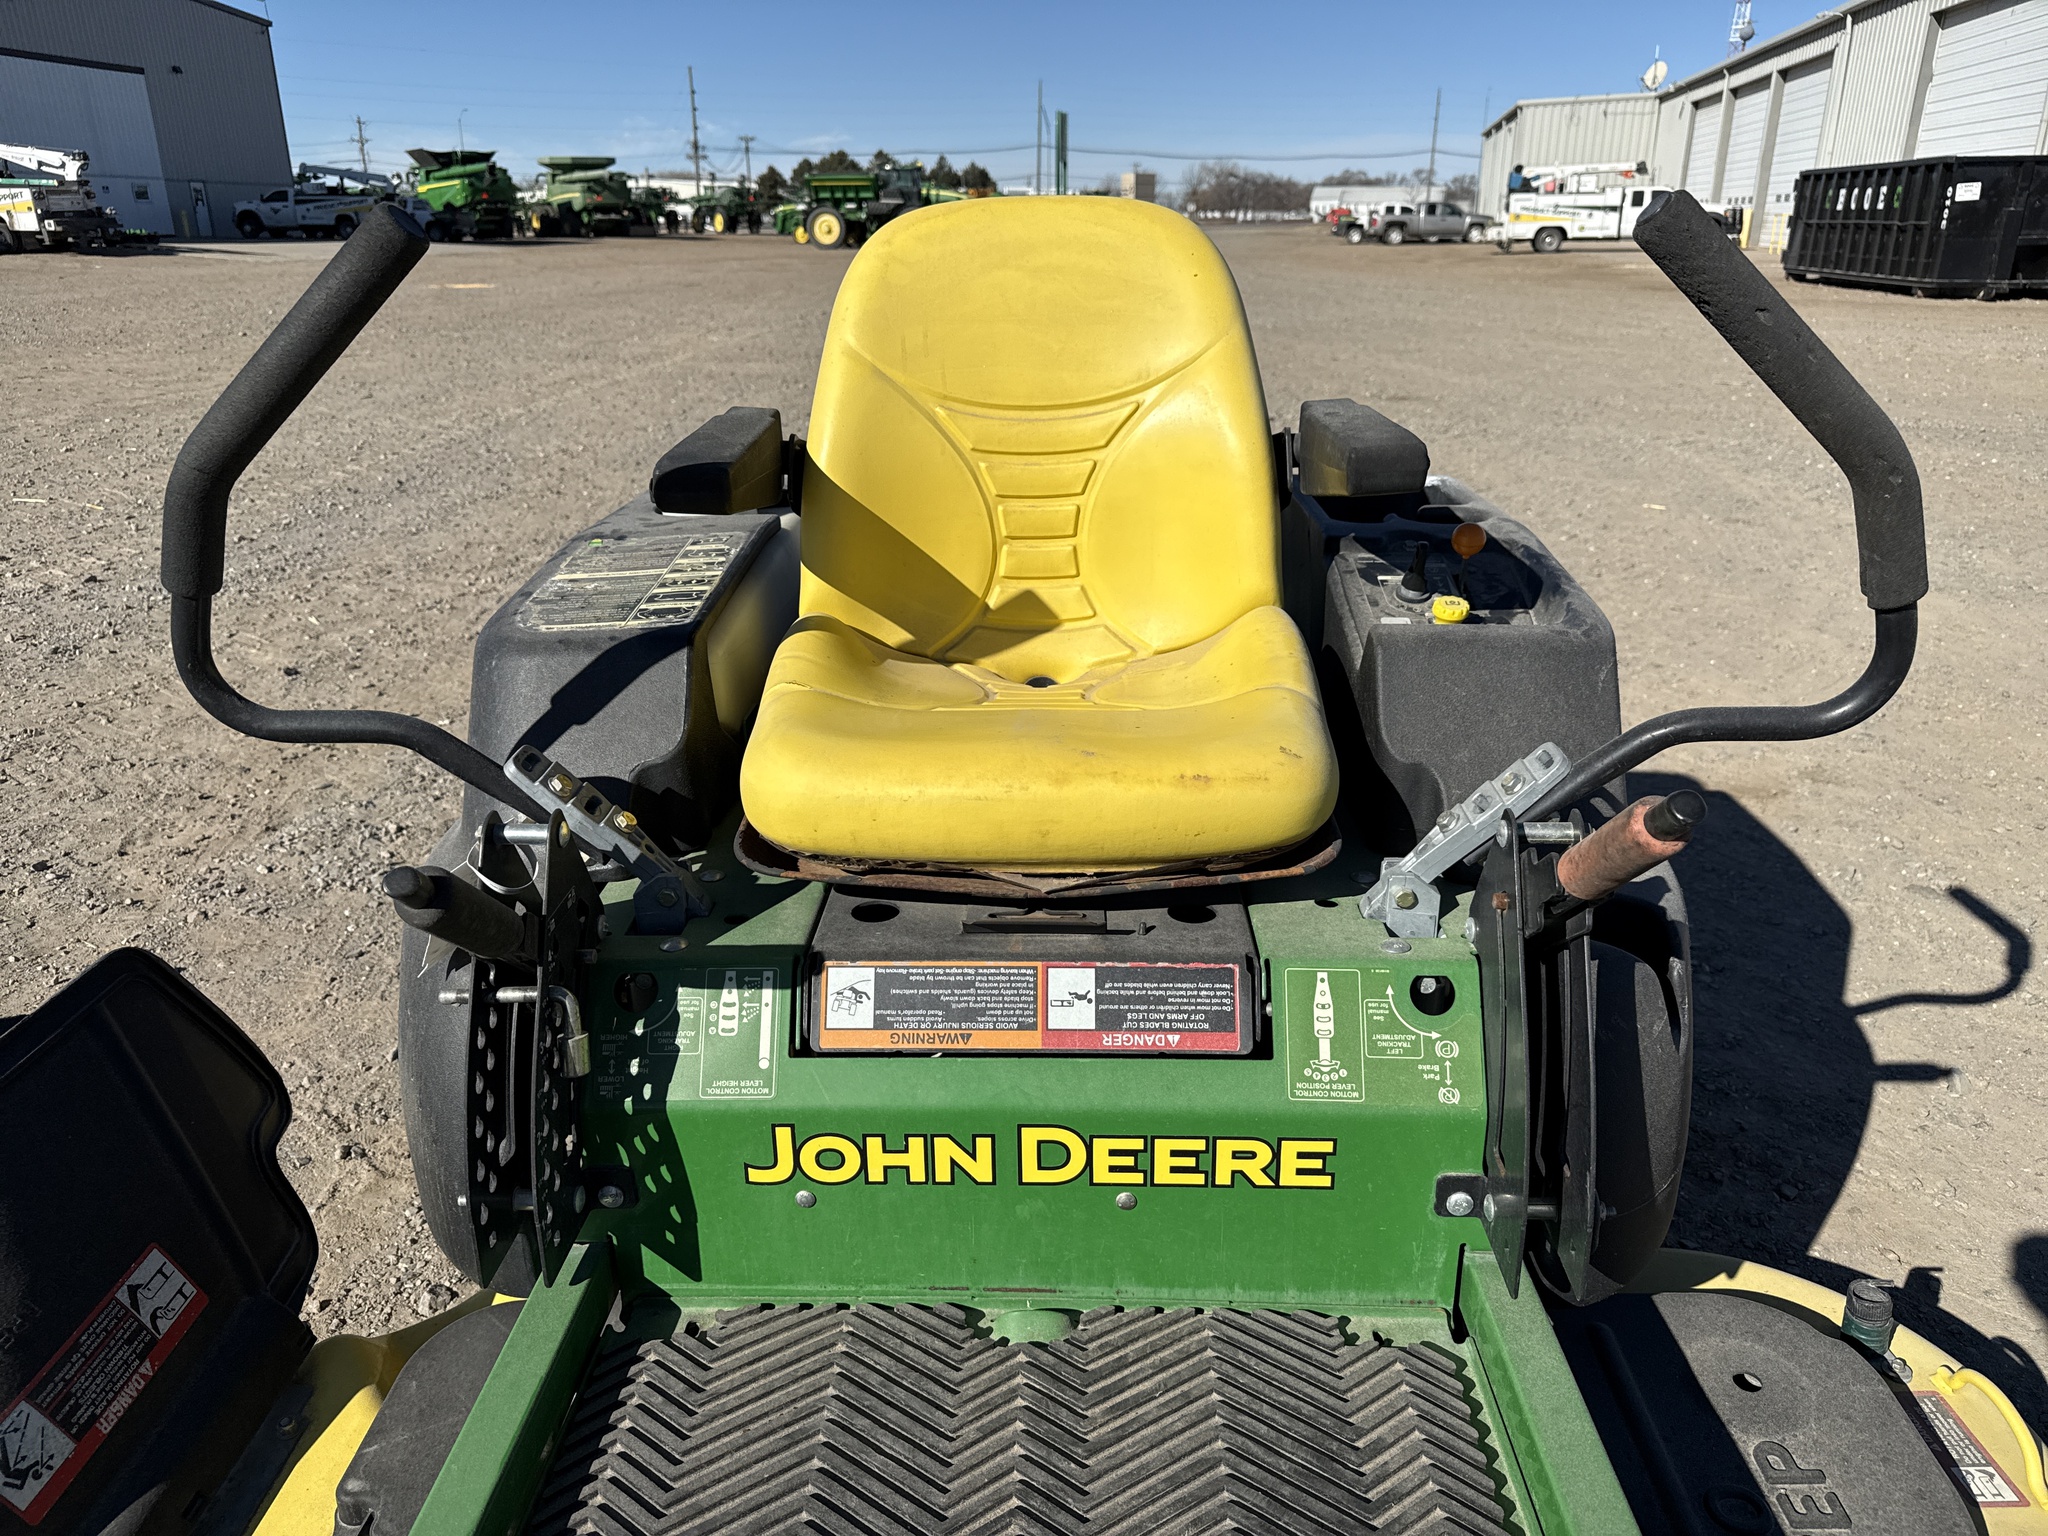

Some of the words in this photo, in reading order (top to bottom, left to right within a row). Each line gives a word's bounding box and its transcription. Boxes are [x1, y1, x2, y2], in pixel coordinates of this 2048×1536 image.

[890, 1033, 960, 1044] WARNING
[1102, 1033, 1165, 1046] DANGER
[745, 1123, 996, 1186] JOHN
[1017, 1123, 1338, 1190] DEERE
[104, 1343, 129, 1374] THROWN
[78, 1372, 105, 1405] OBJECTS
[112, 1358, 140, 1392] ROTATING
[94, 1391, 115, 1416] BLADE
[95, 1373, 146, 1435] DANGER
